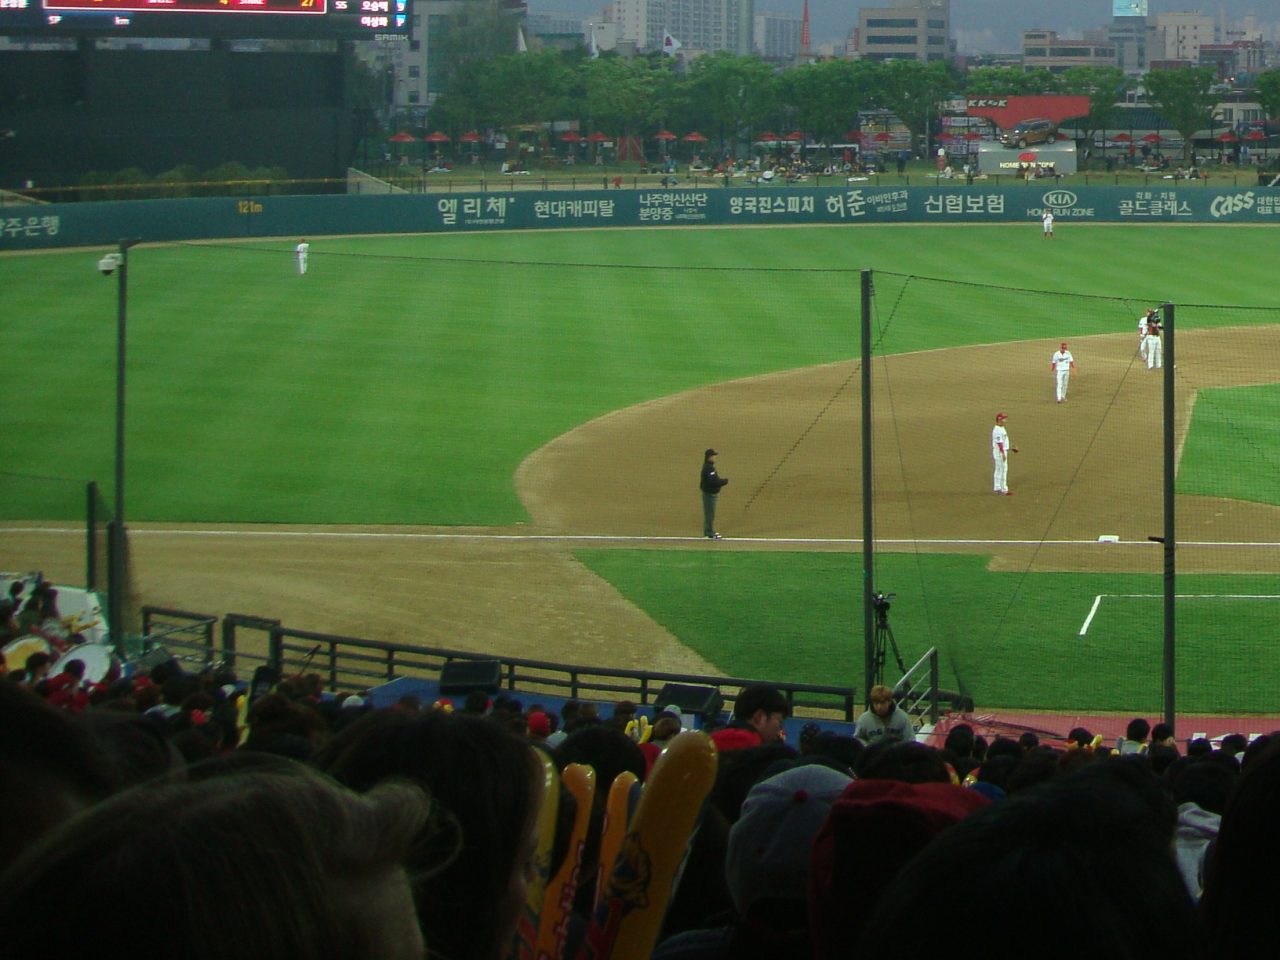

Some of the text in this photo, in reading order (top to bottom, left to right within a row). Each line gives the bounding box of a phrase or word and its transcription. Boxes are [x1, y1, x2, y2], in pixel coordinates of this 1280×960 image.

[335, 1, 348, 10] SS
[639, 193, 708, 208] 나주혁신산단
[730, 196, 814, 214] 양국진스피치
[826, 190, 867, 218] 허준
[924, 194, 1004, 214] 신협보험
[1050, 194, 1071, 205] KIA
[237, 201, 263, 214] 121m
[534, 200, 615, 218] 현대캐피탈
[638, 208, 673, 221] 분양중
[1053, 208, 1071, 216] RUN
[1073, 207, 1094, 216] ZONE
[1118, 200, 1192, 216] 골드클래스
